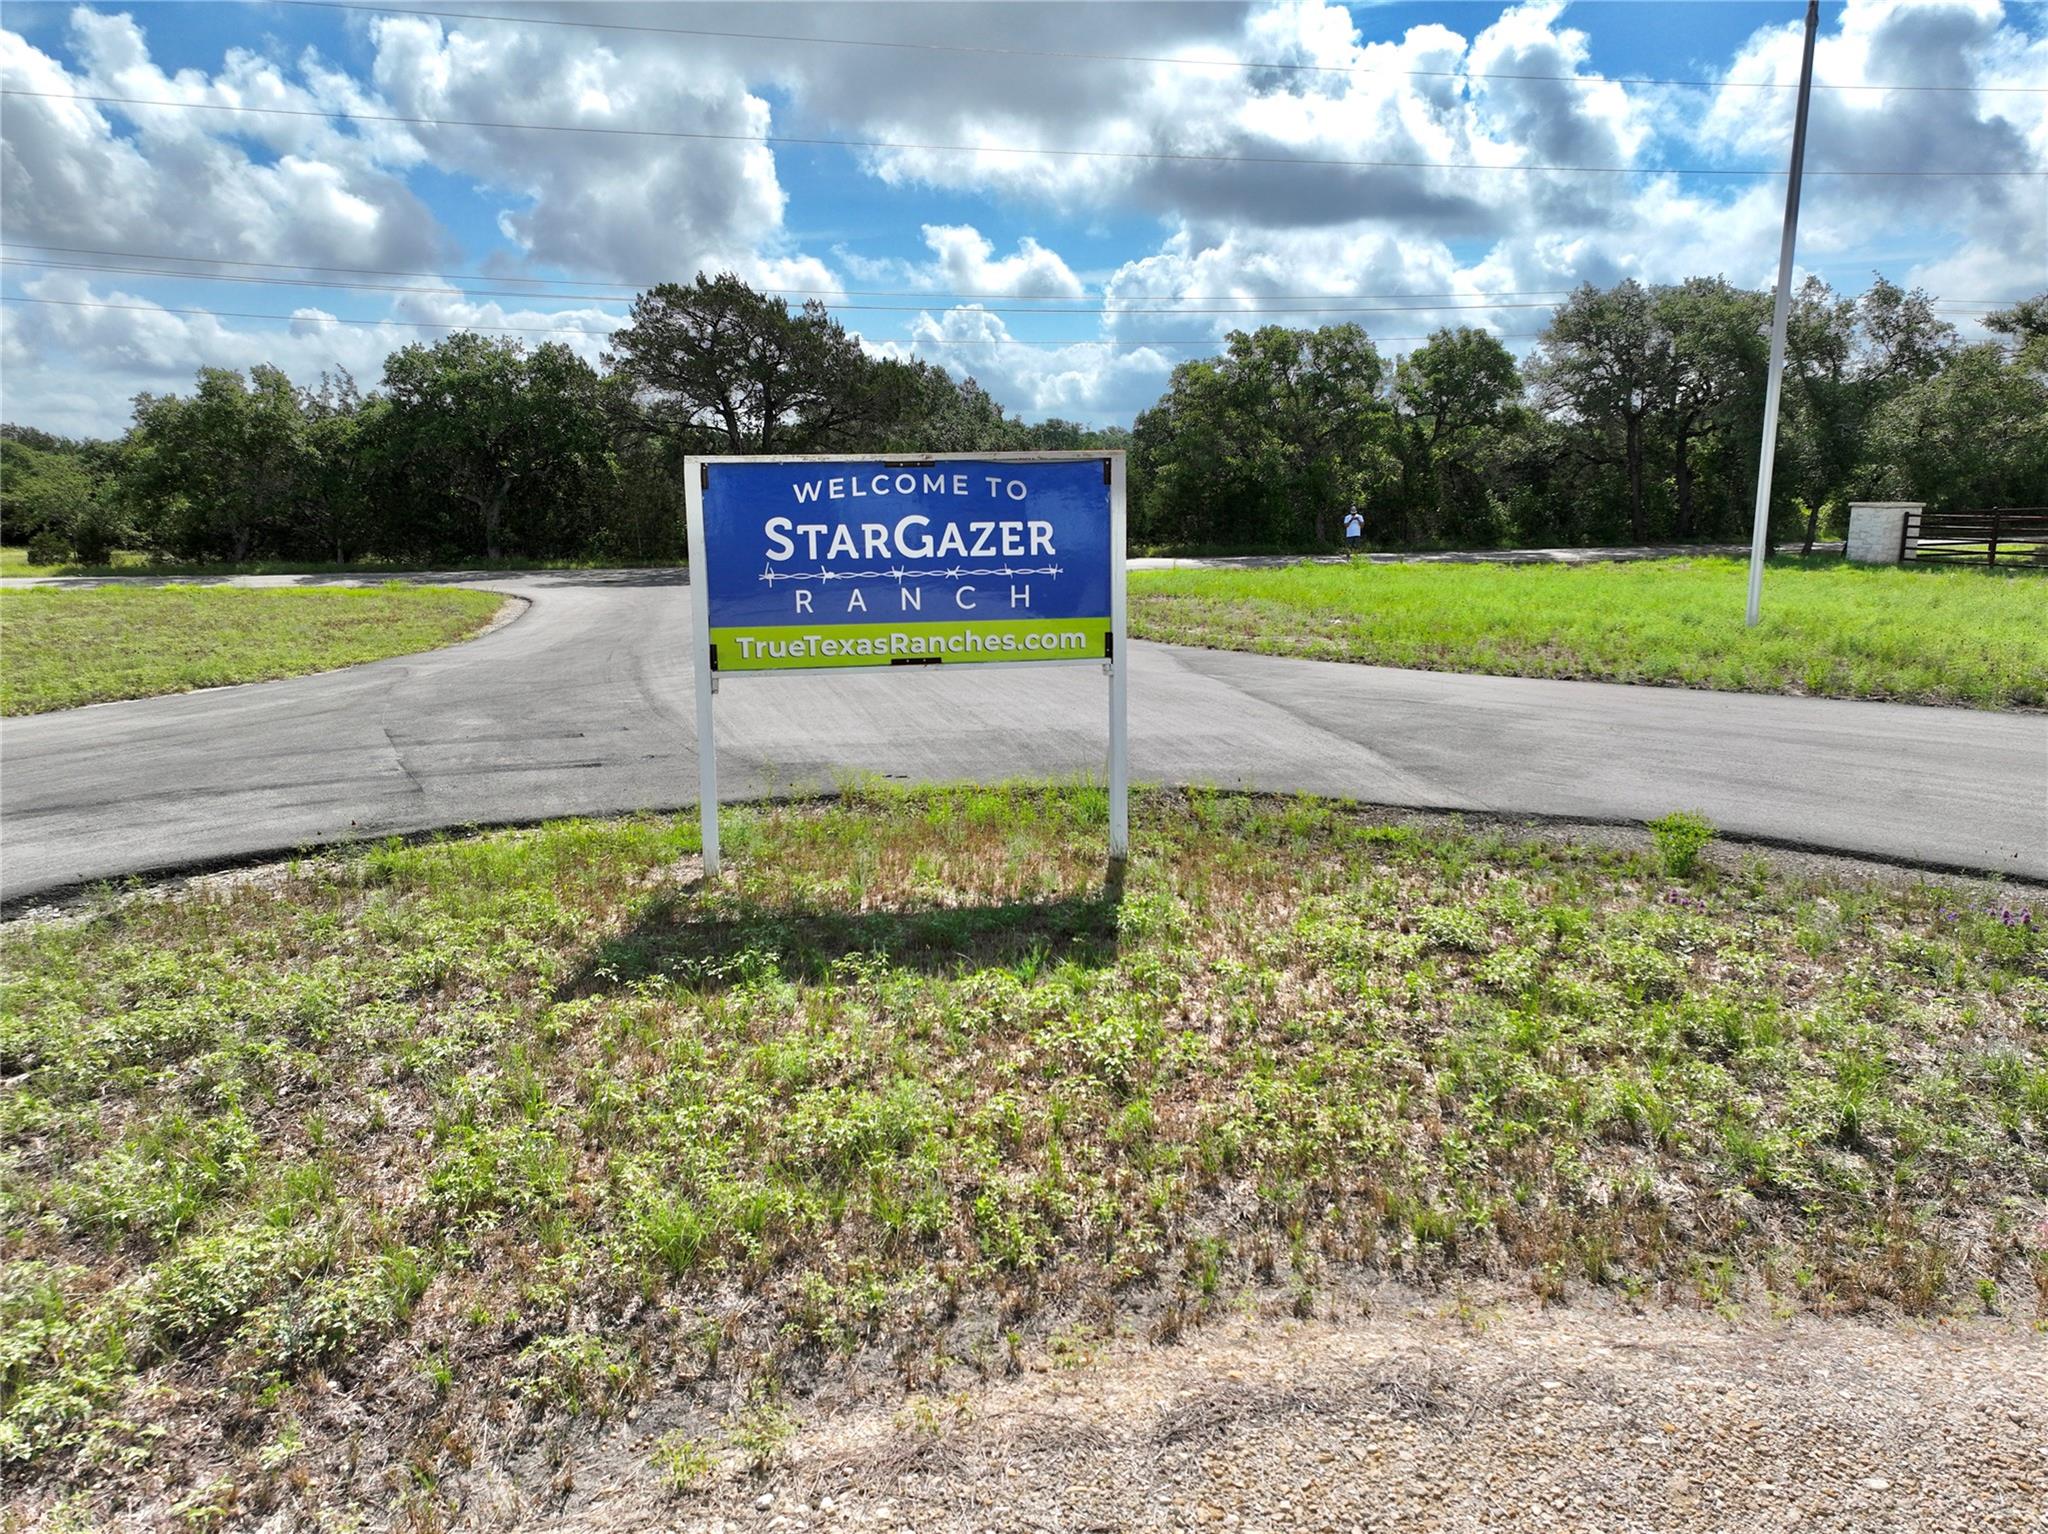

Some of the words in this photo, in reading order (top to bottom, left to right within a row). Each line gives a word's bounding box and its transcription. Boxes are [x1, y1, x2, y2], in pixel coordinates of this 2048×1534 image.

[793, 474, 968, 504] WELCOME
[985, 477, 1028, 501] TO
[795, 584, 1031, 614] RANCH
[735, 629, 1087, 660] TrueTexasRanches.com
